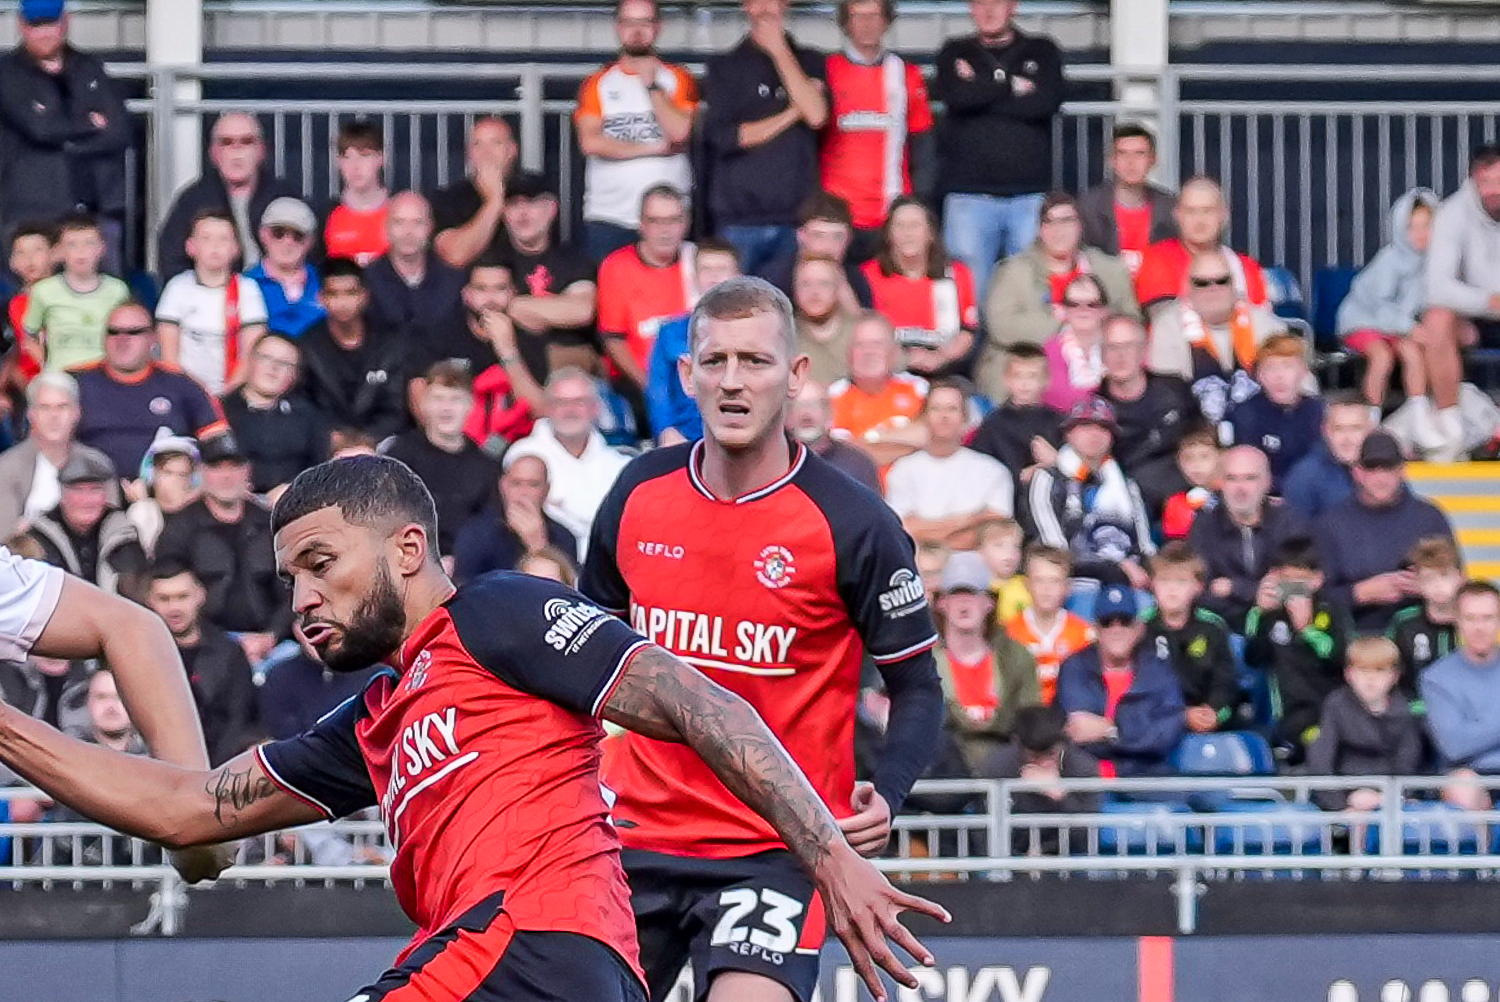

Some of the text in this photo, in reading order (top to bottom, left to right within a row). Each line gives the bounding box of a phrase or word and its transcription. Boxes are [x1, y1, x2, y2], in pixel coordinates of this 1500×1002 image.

[636, 541, 686, 561] REFLO
[734, 620, 797, 664] SKY
[403, 706, 461, 777] SKY
[710, 887, 804, 954] 23
[729, 941, 784, 966] REFLO
